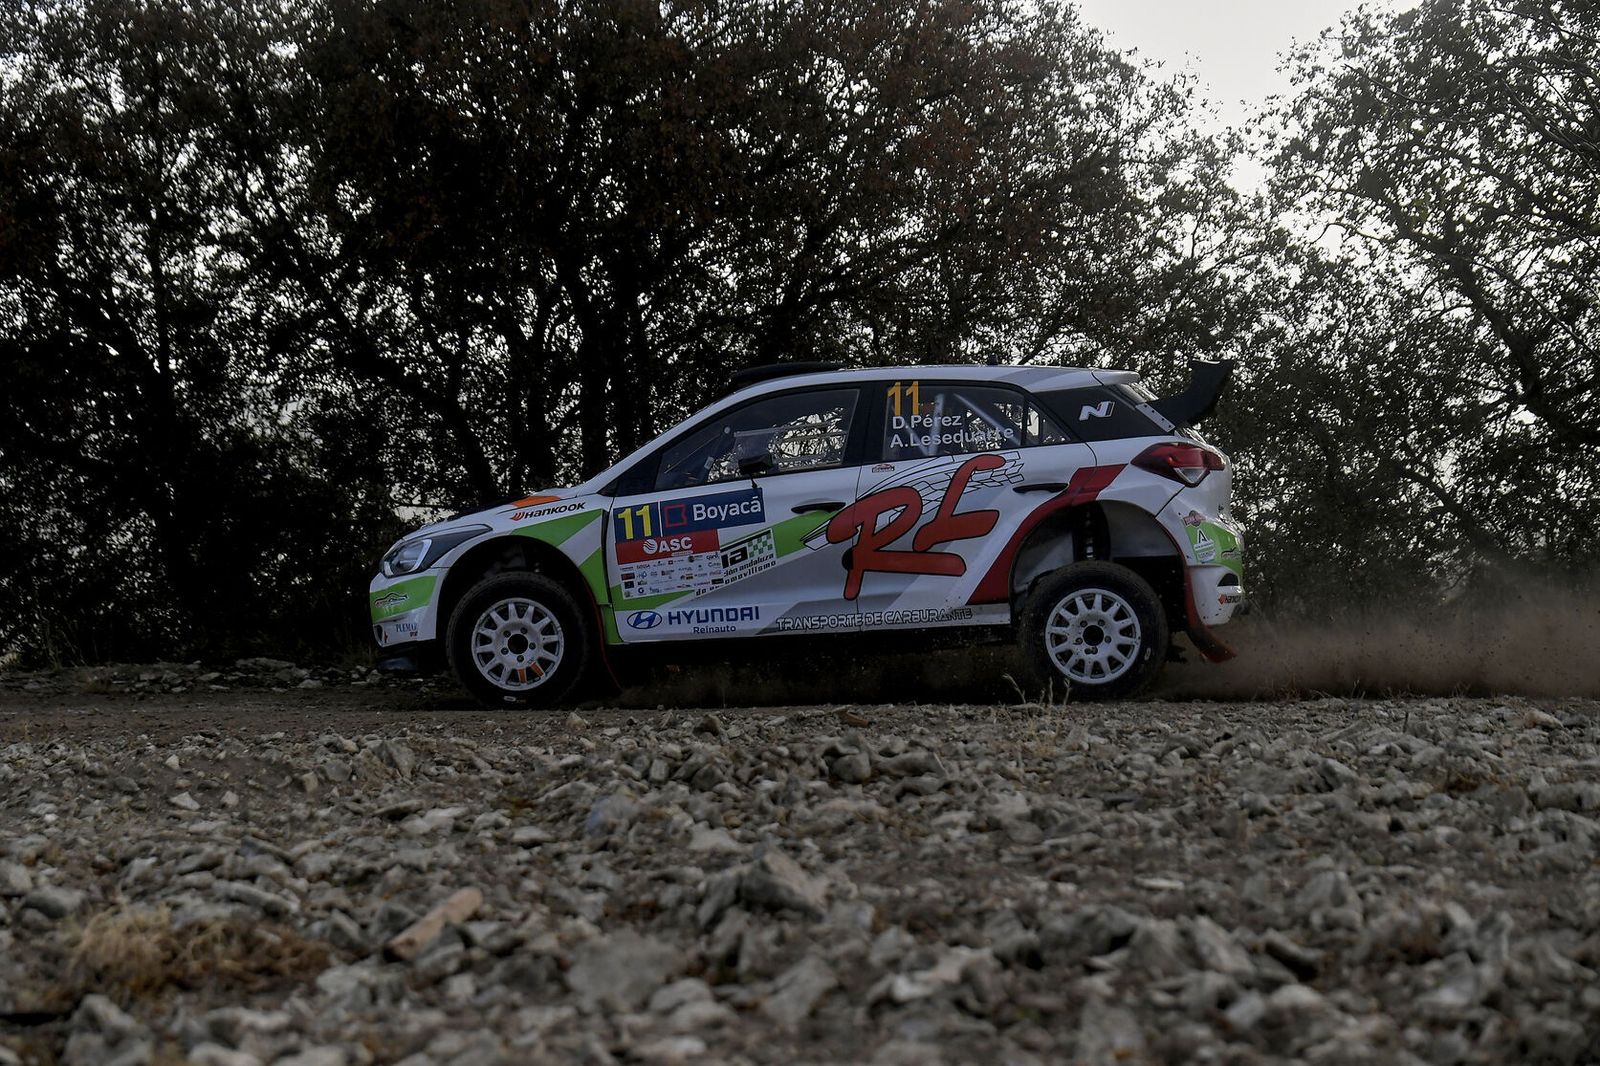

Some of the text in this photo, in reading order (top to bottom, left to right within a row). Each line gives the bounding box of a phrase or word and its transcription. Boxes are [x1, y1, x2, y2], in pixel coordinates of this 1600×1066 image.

[887, 381, 919, 416] 11
[692, 497, 762, 522] Boyacá
[617, 504, 652, 540] 11
[658, 536, 693, 552] ASC
[739, 553, 774, 572] andaluza
[695, 588, 707, 596] de
[668, 606, 760, 625] HYUNDAI
[776, 608, 973, 631] TRANSPORTE DE CARBURANTE
[693, 625, 736, 634] Reinauto
